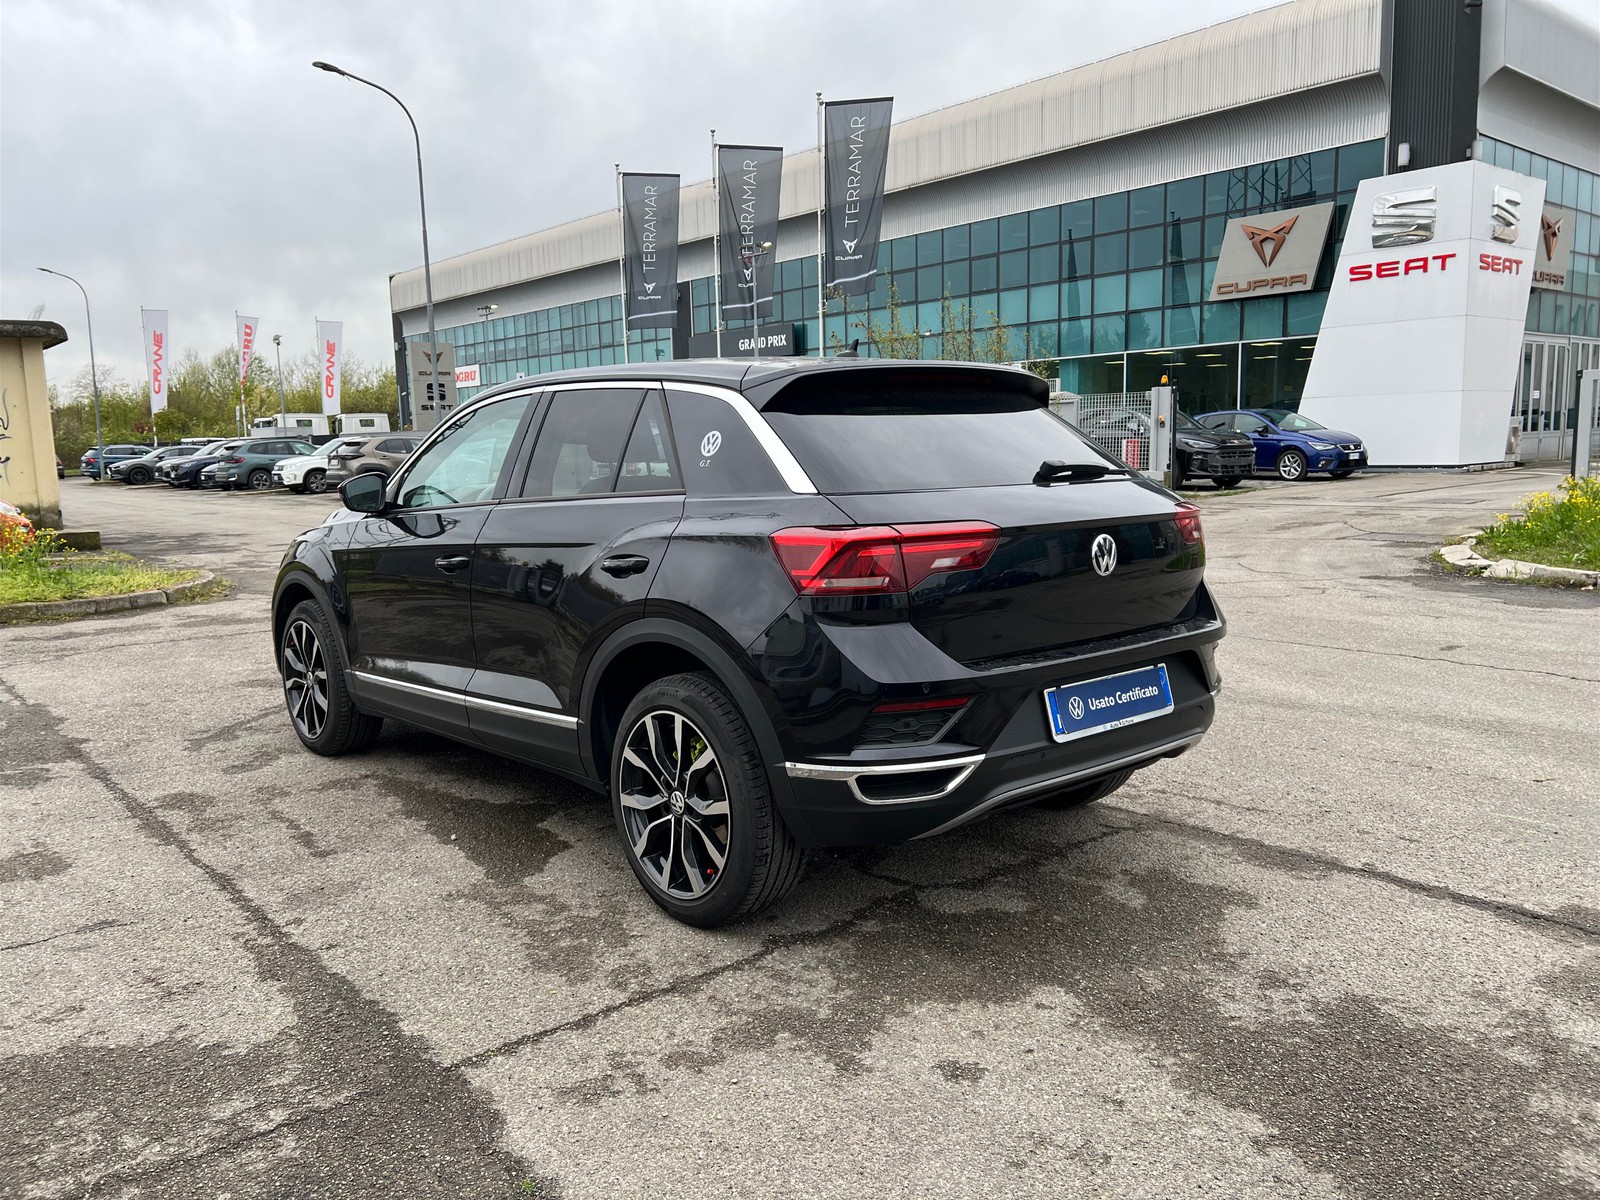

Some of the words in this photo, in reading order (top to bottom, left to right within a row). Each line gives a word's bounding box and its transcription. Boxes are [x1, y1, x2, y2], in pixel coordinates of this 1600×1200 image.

[844, 115, 866, 228] TERRAMAR
[642, 185, 658, 274] TERRAMAR
[1349, 253, 1457, 282] SEAT
[1479, 253, 1523, 275] SEAT
[1216, 273, 1307, 295] CUPRA
[1532, 270, 1564, 286] UPRA
[767, 334, 787, 348] PRIX
[153, 330, 163, 395] CRANE
[325, 340, 336, 398] CRANE
[1088, 696, 1115, 710] Usato
[1115, 685, 1159, 704] Certificato
